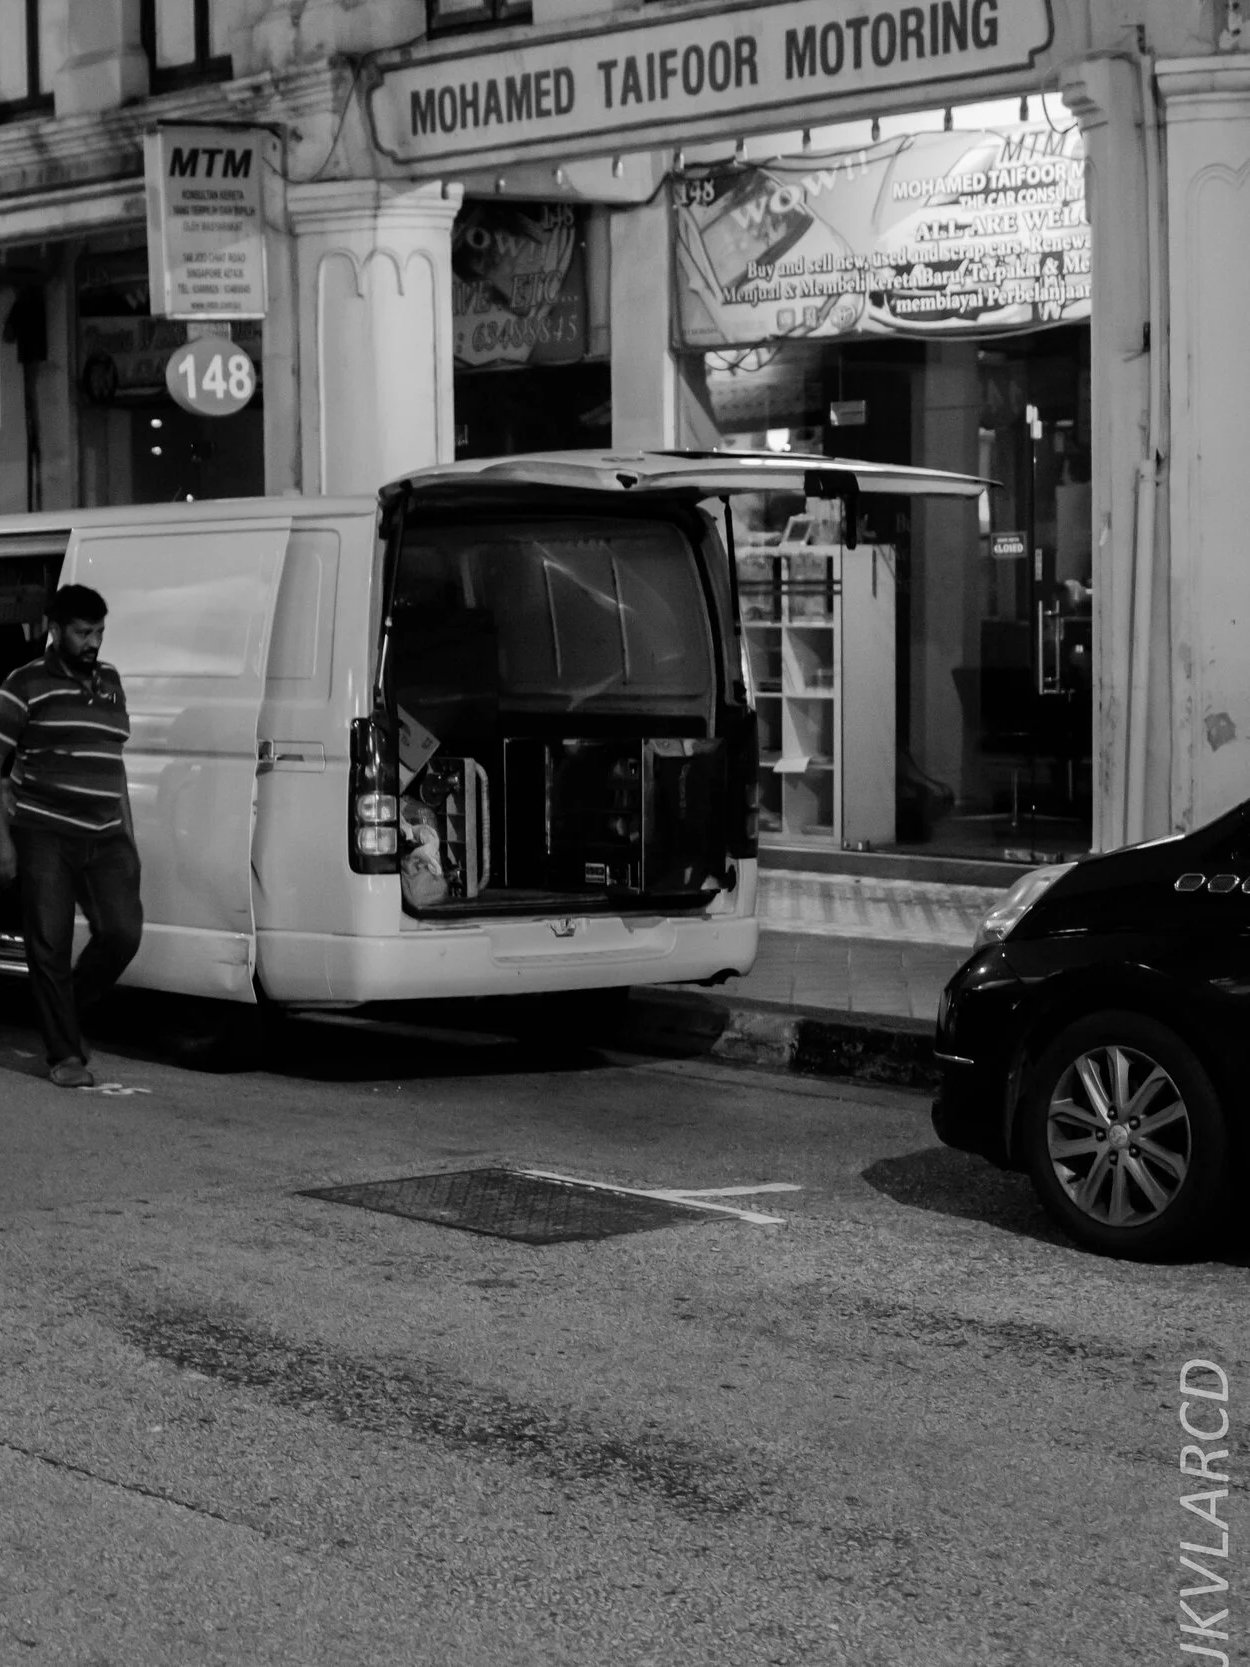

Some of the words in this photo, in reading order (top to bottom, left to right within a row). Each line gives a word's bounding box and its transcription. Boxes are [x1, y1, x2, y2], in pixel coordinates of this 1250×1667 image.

[410, 66, 575, 137] MOHAMED
[597, 34, 759, 109] TAIFOOR
[785, 0, 999, 80] MOTORING
[168, 147, 253, 178] MTM
[679, 177, 716, 204] 148
[893, 171, 987, 200] MOHAMED
[988, 163, 1066, 191] TAIFOOR
[915, 219, 964, 242] ALL
[971, 212, 1018, 237] ARE
[747, 261, 775, 283] Buy
[777, 256, 807, 277] and
[808, 253, 834, 273] sell
[872, 244, 908, 268] used
[909, 240, 940, 264] and
[942, 243, 986, 264] scrap
[721, 282, 781, 307] Menjual
[783, 281, 798, 299] &
[799, 273, 867, 298] Membeli
[967, 258, 1041, 286] Terpakai
[1042, 256, 1060, 276] &
[895, 287, 984, 315] membiayai
[178, 353, 252, 399] 148
